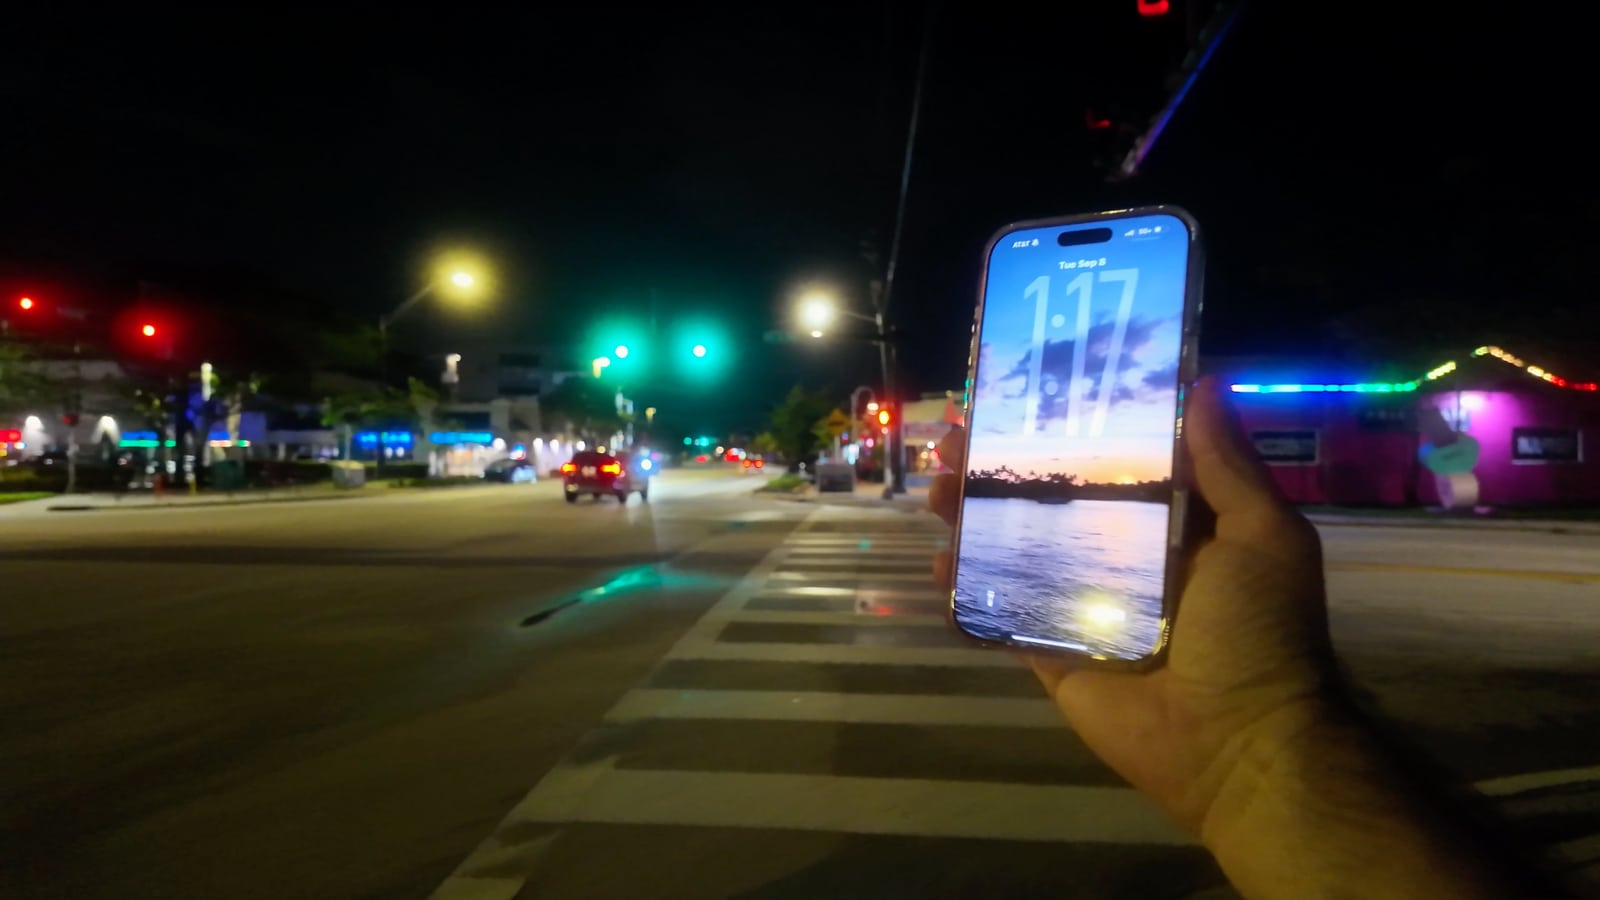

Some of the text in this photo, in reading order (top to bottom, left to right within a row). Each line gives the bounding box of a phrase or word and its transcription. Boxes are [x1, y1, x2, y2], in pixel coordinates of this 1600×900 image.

[1012, 241, 1030, 249] AT&T
[1059, 261, 1076, 269] Tue
[1078, 259, 1097, 269] Sep
[1023, 268, 1139, 436] 1:17
